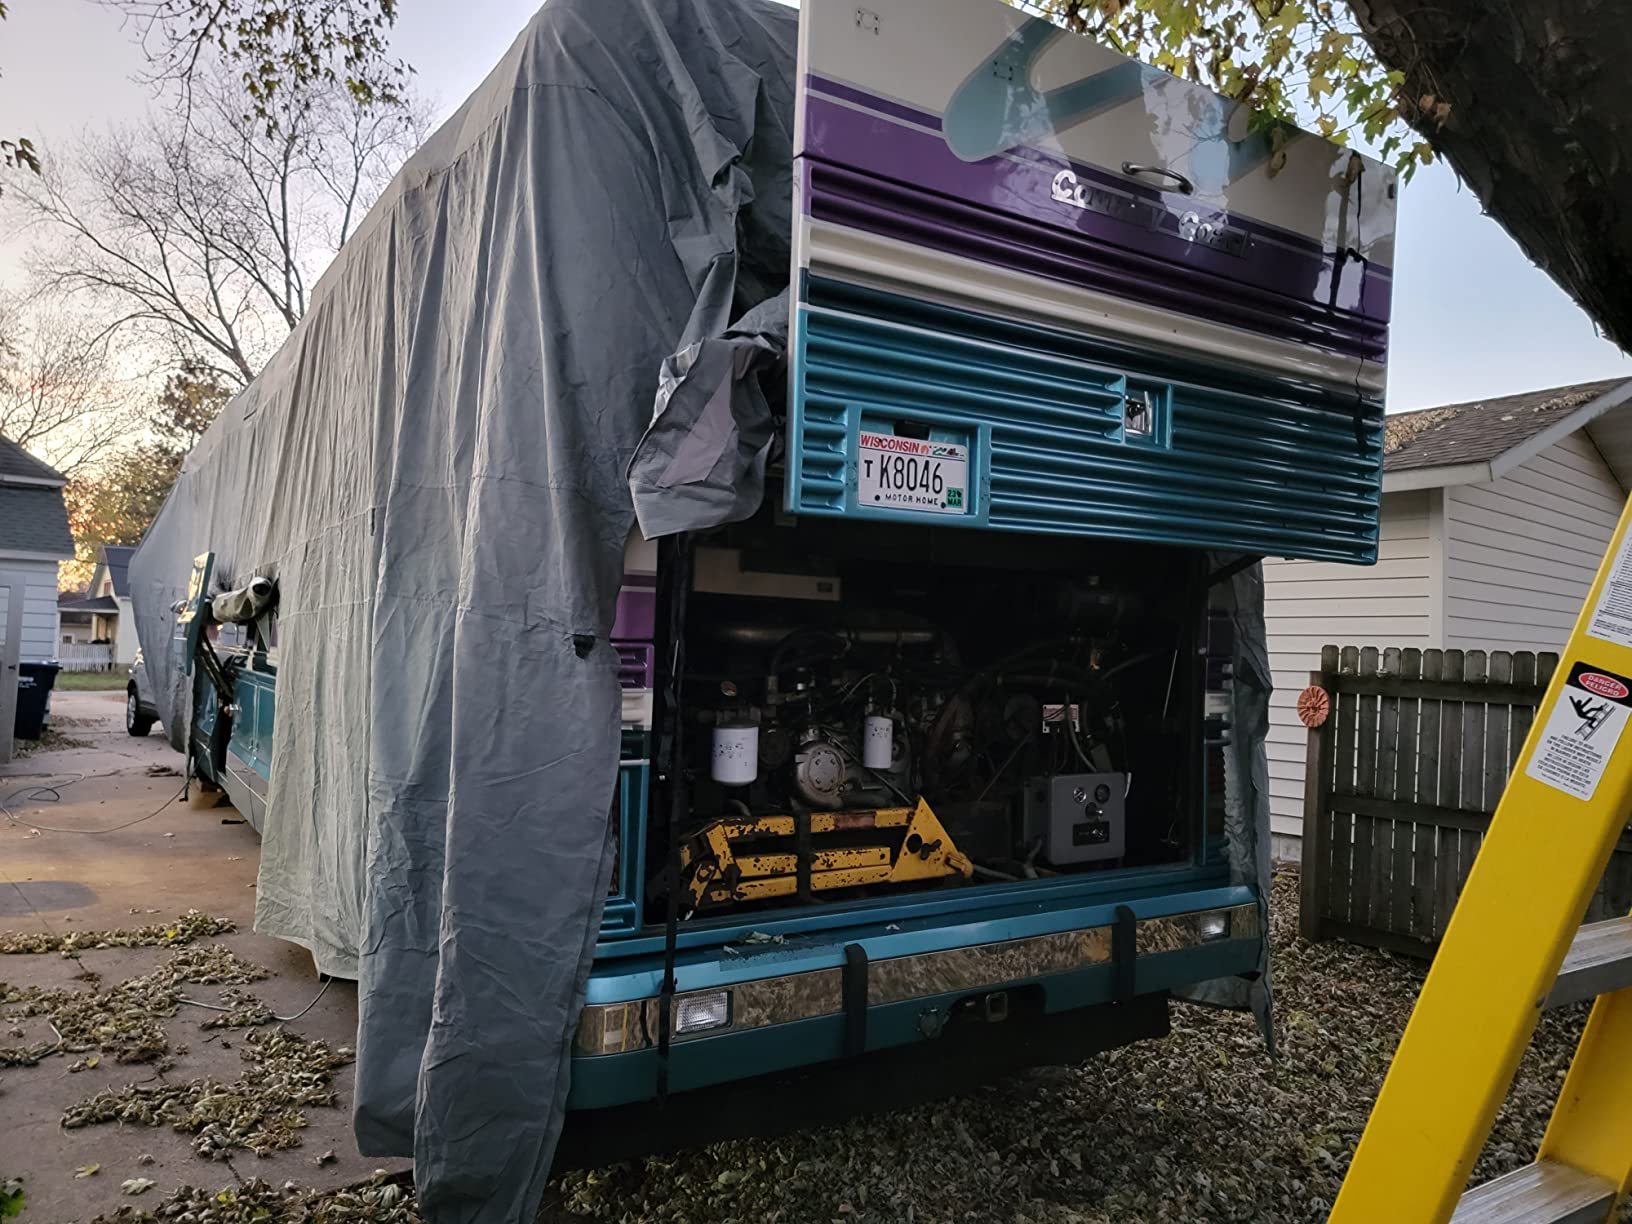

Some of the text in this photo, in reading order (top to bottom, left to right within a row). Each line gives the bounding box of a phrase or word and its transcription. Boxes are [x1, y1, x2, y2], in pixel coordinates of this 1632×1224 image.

[861, 434, 920, 454] WISCONSIN
[880, 454, 943, 494] K8046
[885, 493, 938, 506] MOTOR HOME
[947, 497, 961, 507] MAR
[1586, 680, 1620, 696] PELIGRO
[1588, 674, 1621, 689] DANGER
